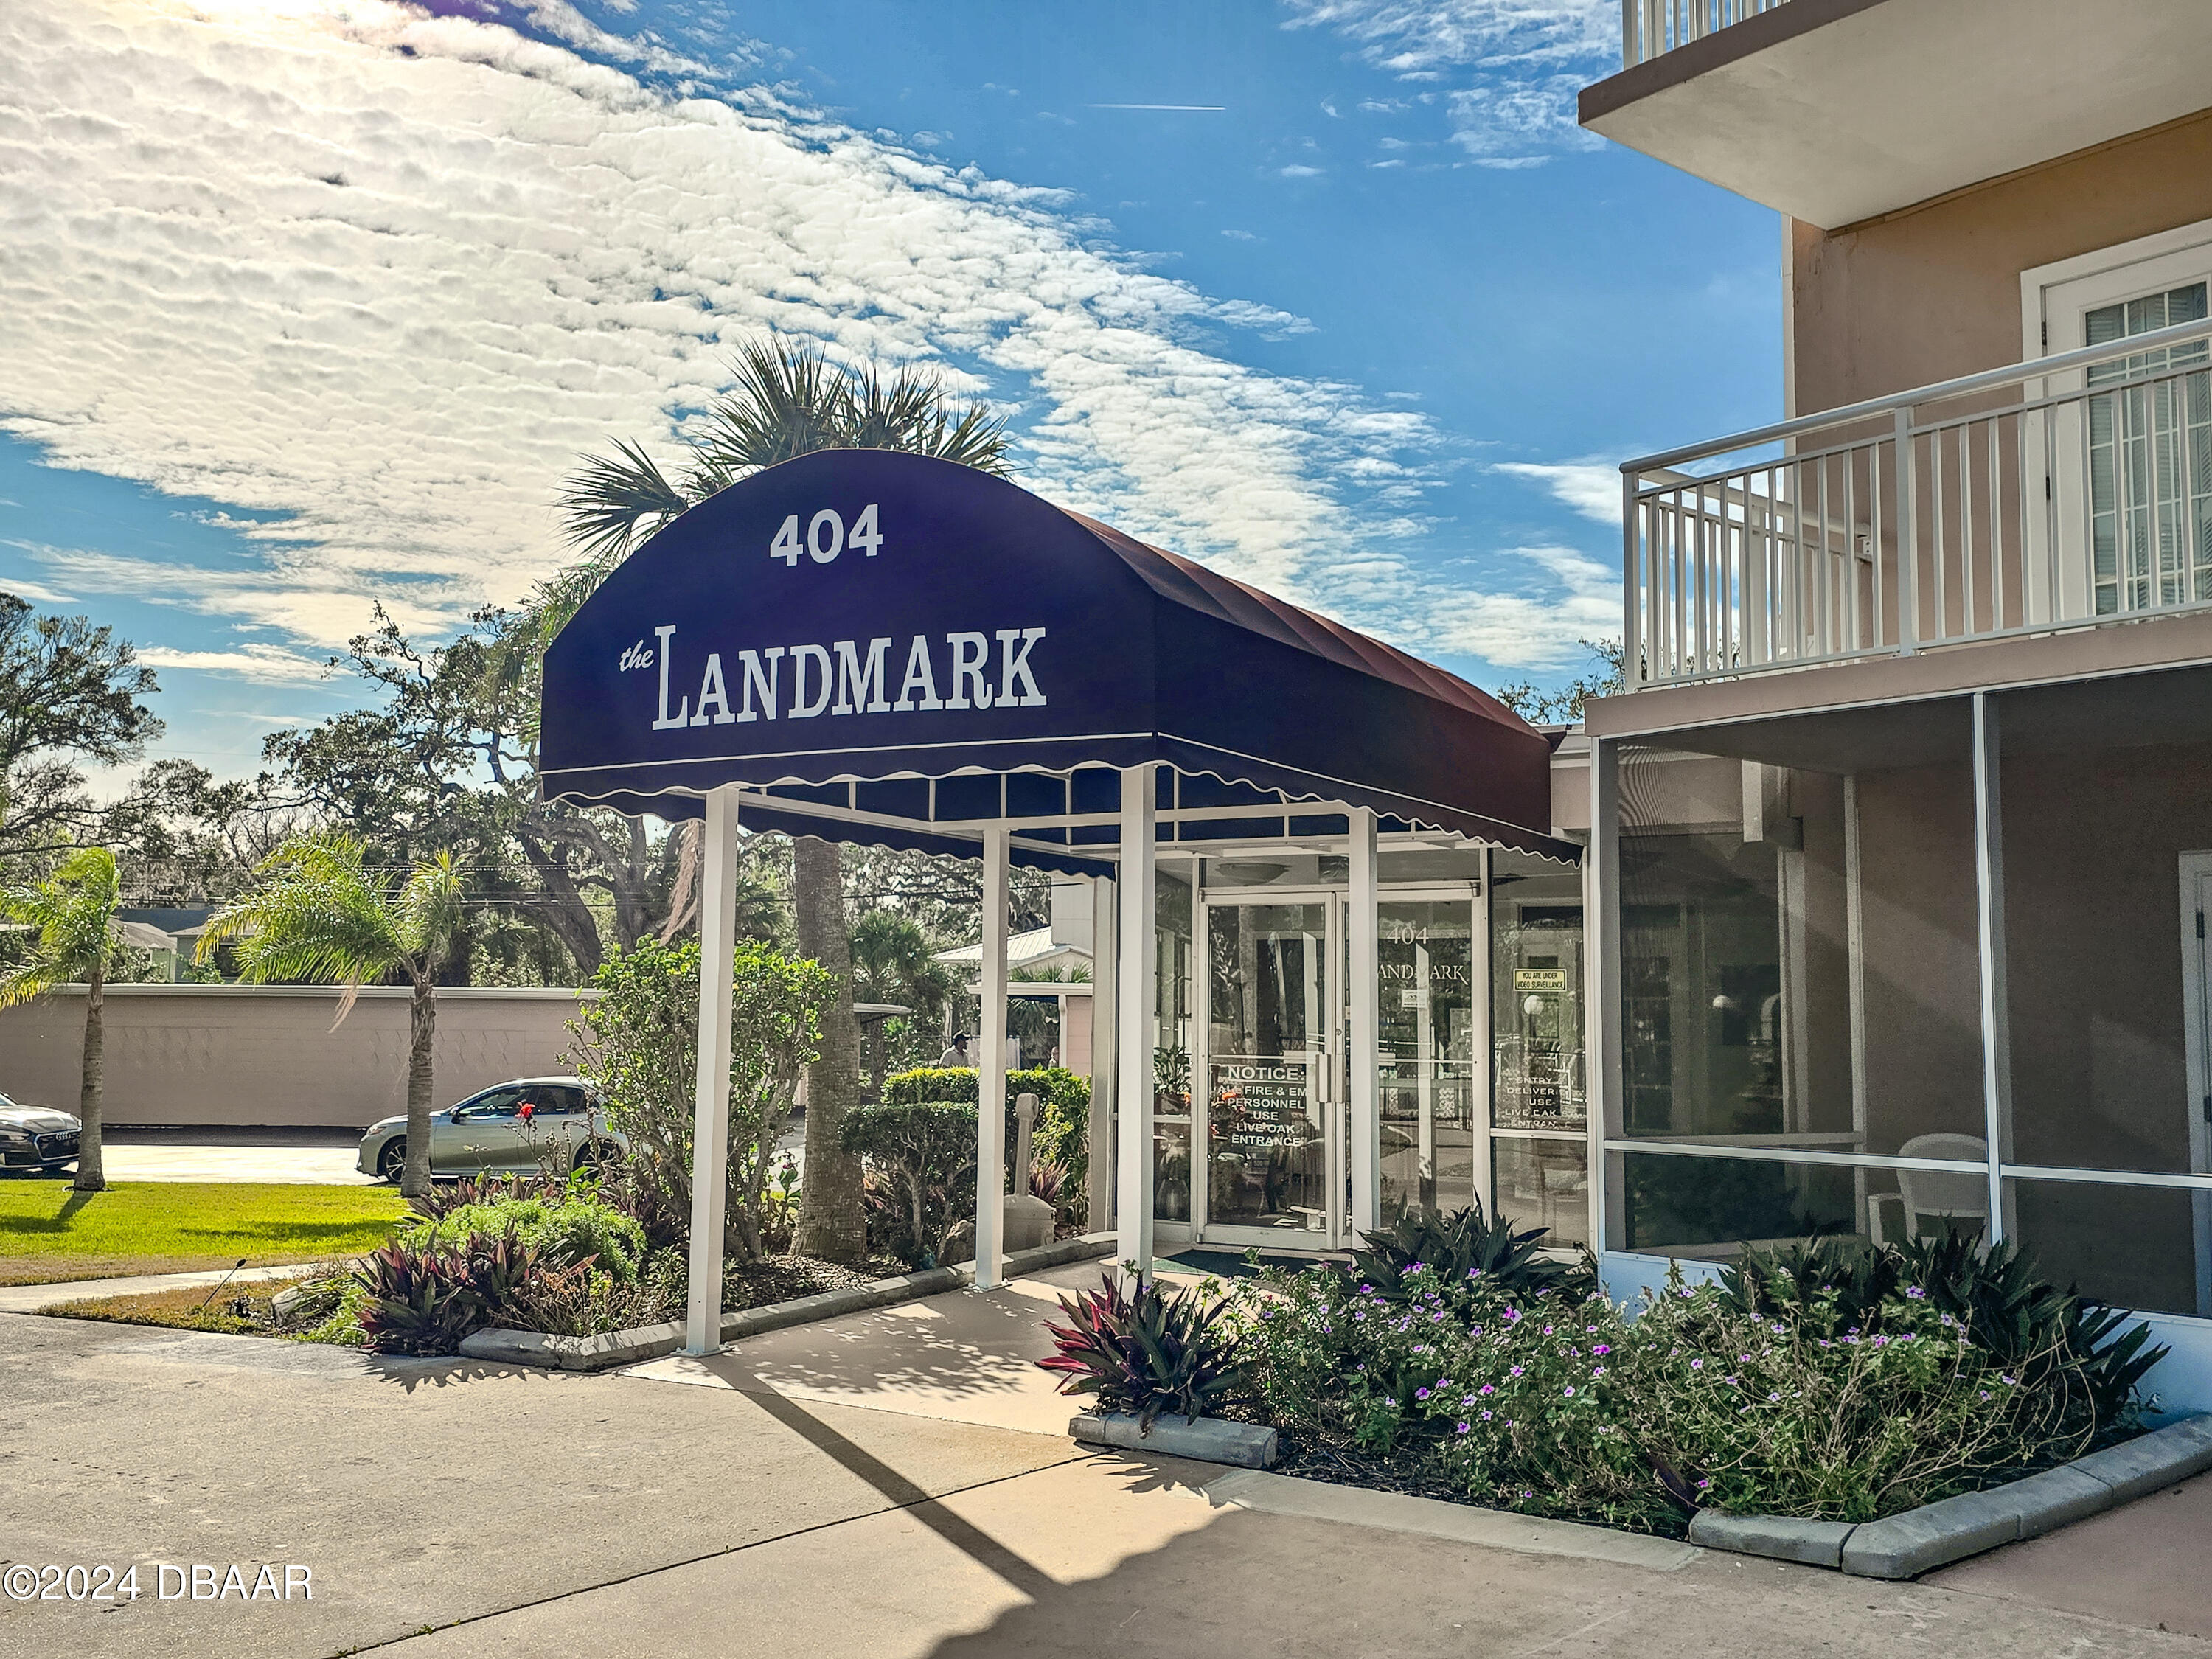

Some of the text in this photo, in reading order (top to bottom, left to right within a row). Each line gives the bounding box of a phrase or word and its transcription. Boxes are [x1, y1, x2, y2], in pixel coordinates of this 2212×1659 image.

[770, 504, 883, 566] 404
[619, 625, 1047, 731] the LANDMARK
[1386, 926, 1429, 945] 404
[1523, 972, 1531, 980] YOU
[1227, 1066, 1304, 1081] NOTICE:
[1245, 1085, 1273, 1096] FIRE
[1276, 1086, 1285, 1096] &
[1227, 1097, 1306, 1110] PERSONNEL
[1529, 1098, 1553, 1107] USE
[1253, 1110, 1279, 1121] USE
[1505, 1108, 1529, 1116] LIVE
[1236, 1122, 1295, 1135] LIVE OAK
[1231, 1134, 1303, 1147] ENTRANCE
